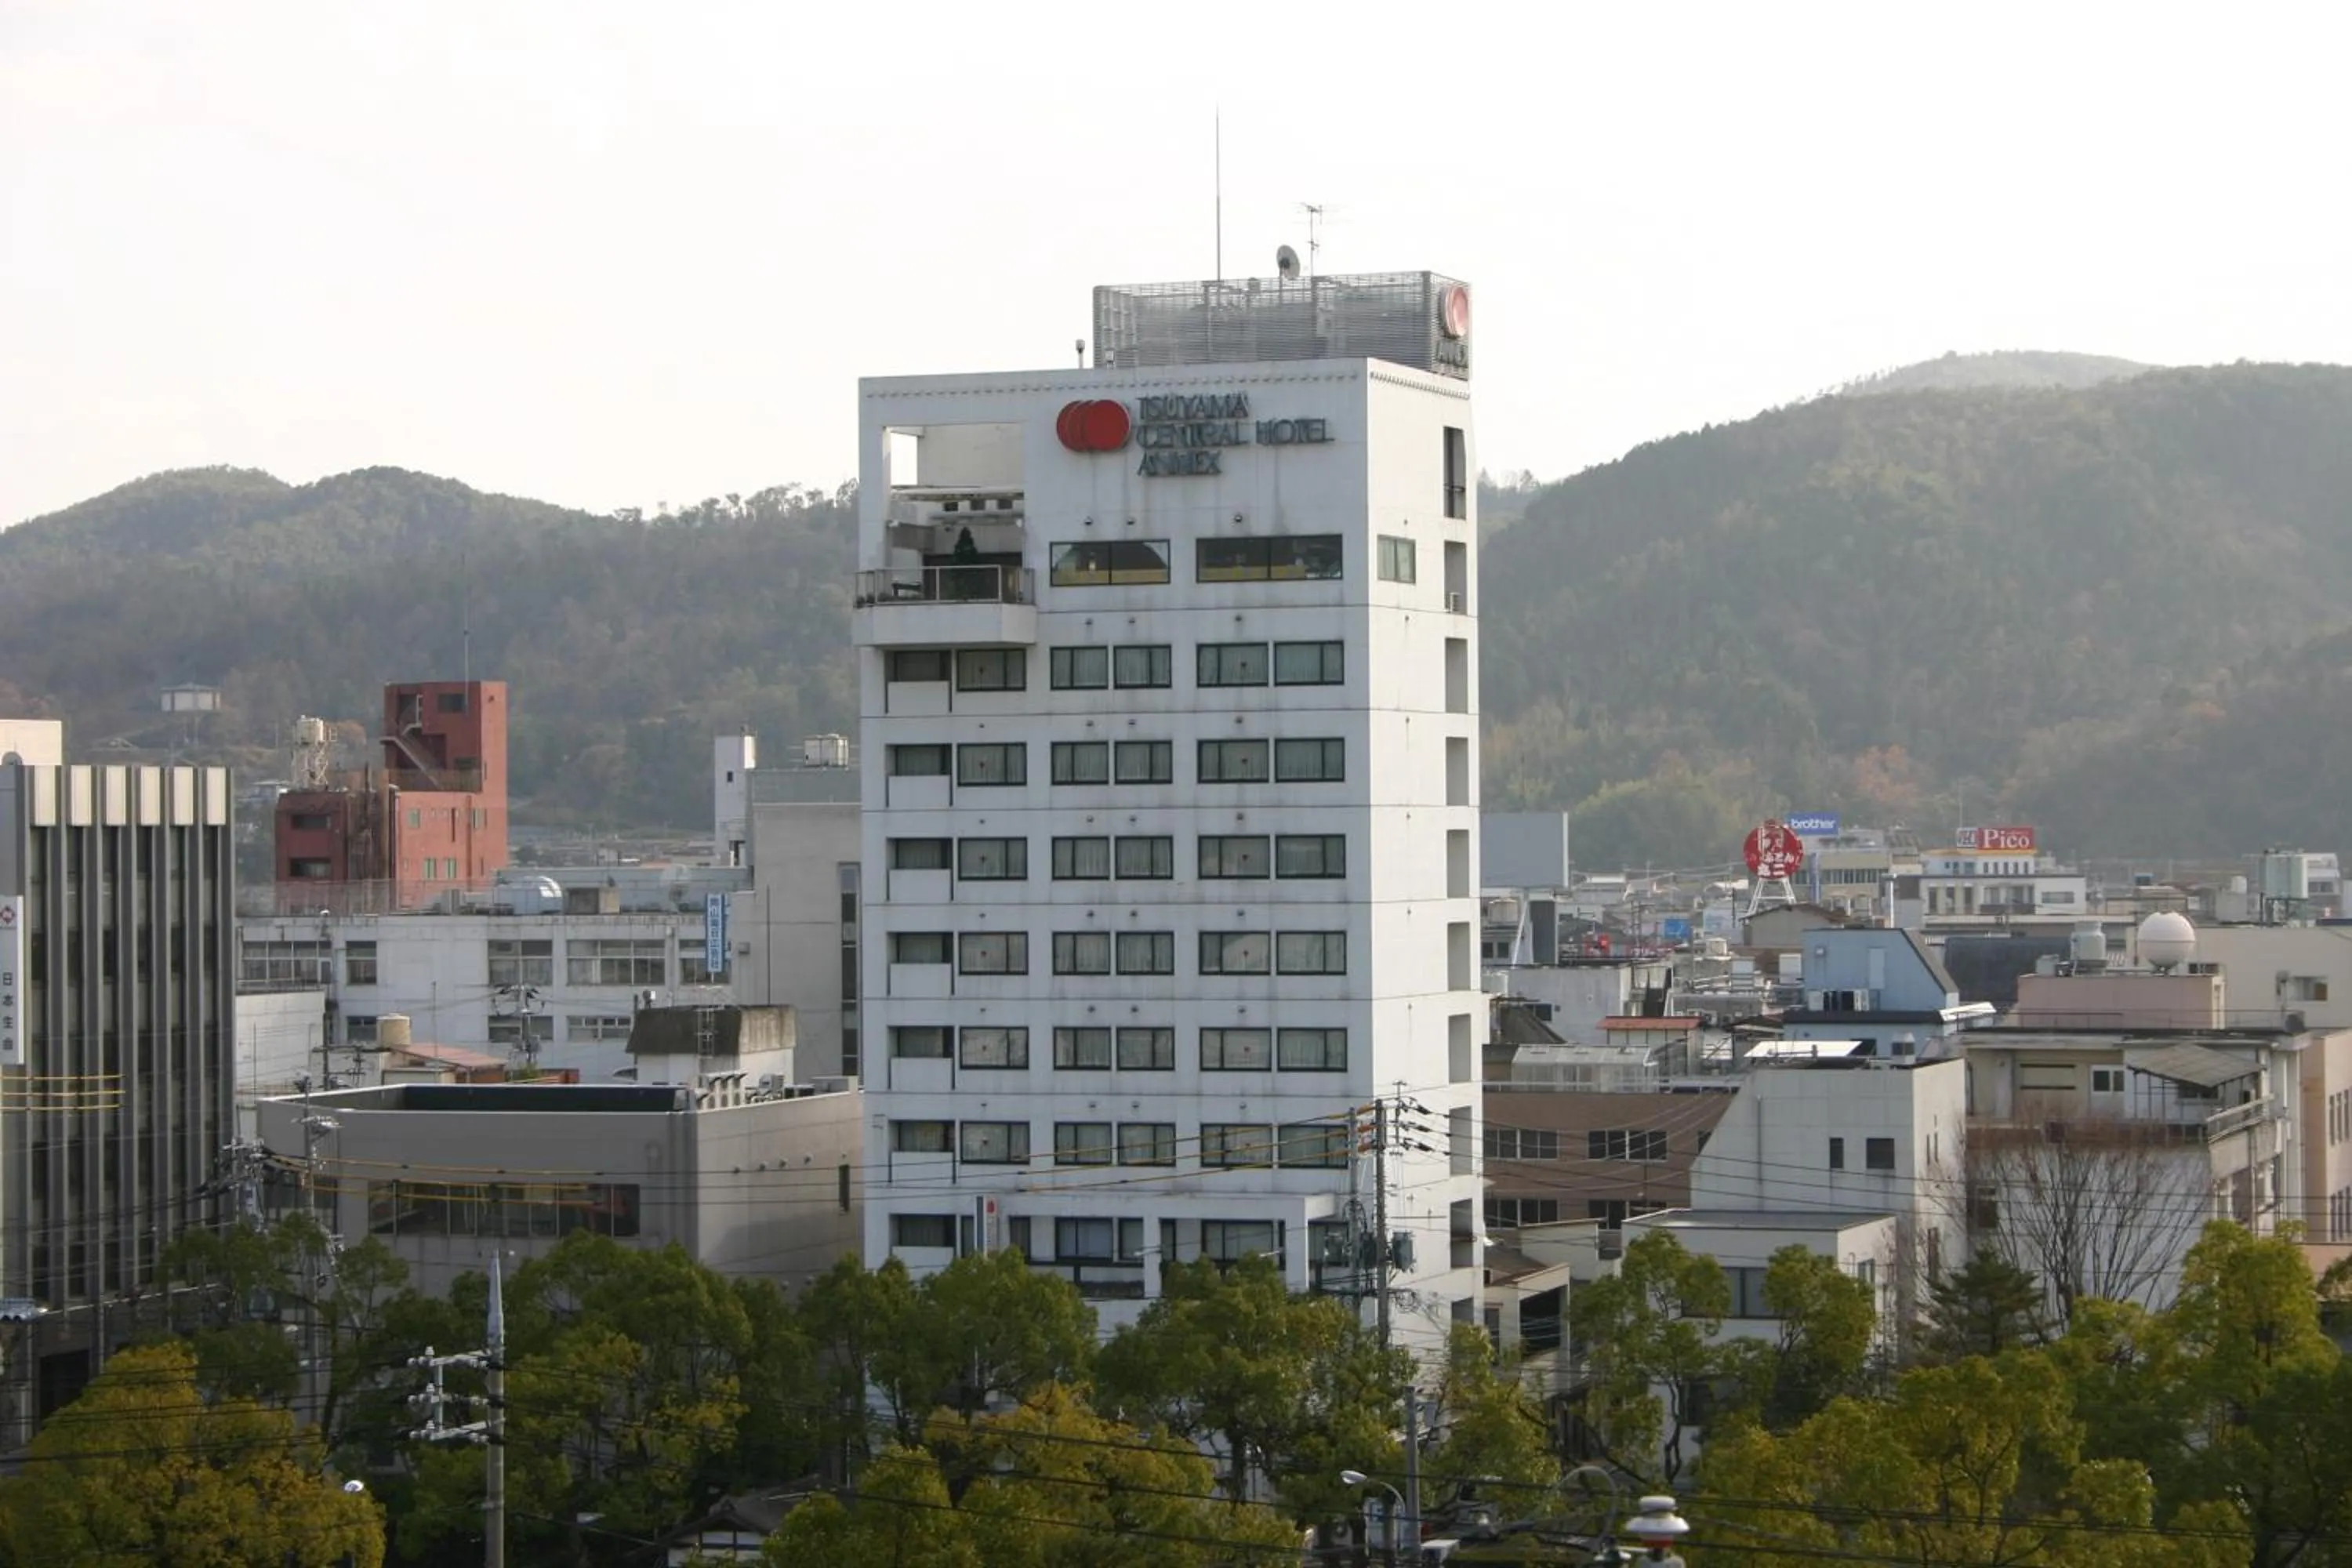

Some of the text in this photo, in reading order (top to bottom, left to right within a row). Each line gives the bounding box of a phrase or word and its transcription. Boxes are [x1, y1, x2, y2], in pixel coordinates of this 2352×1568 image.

[1137, 394, 1250, 420] TSUYAMA
[1137, 418, 1335, 448] CENTRAL HOTEL
[1137, 451, 1222, 476] ANNEX
[1790, 818, 1836, 829] brother
[1984, 829, 2031, 848] Pico
